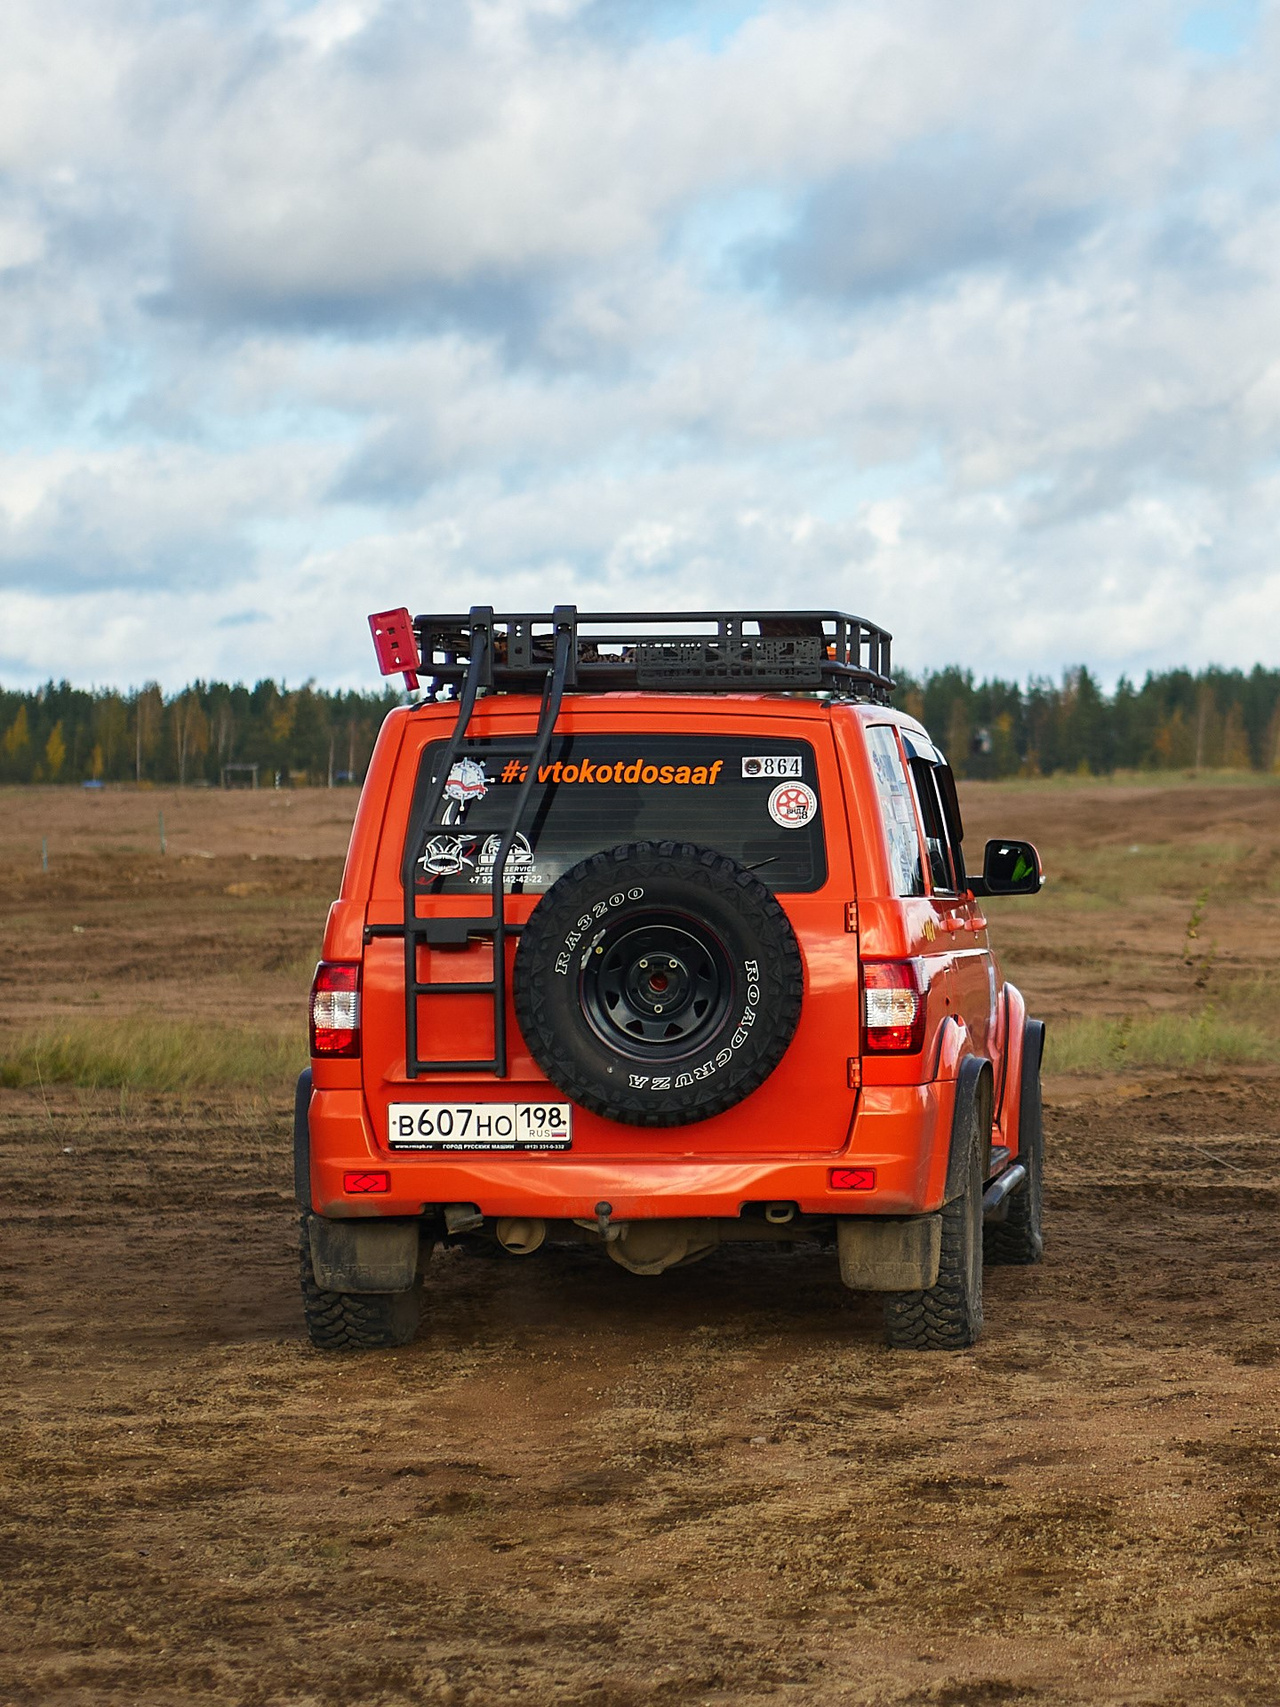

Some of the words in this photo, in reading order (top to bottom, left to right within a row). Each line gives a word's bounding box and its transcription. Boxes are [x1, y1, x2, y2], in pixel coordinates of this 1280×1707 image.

[763, 758, 800, 775] 864
[555, 887, 644, 975] RA3200
[628, 959, 760, 1091] ROADCRUZA
[399, 1108, 513, 1137] В607НО
[519, 1106, 562, 1128] 198
[529, 1129, 551, 1138] RUS
